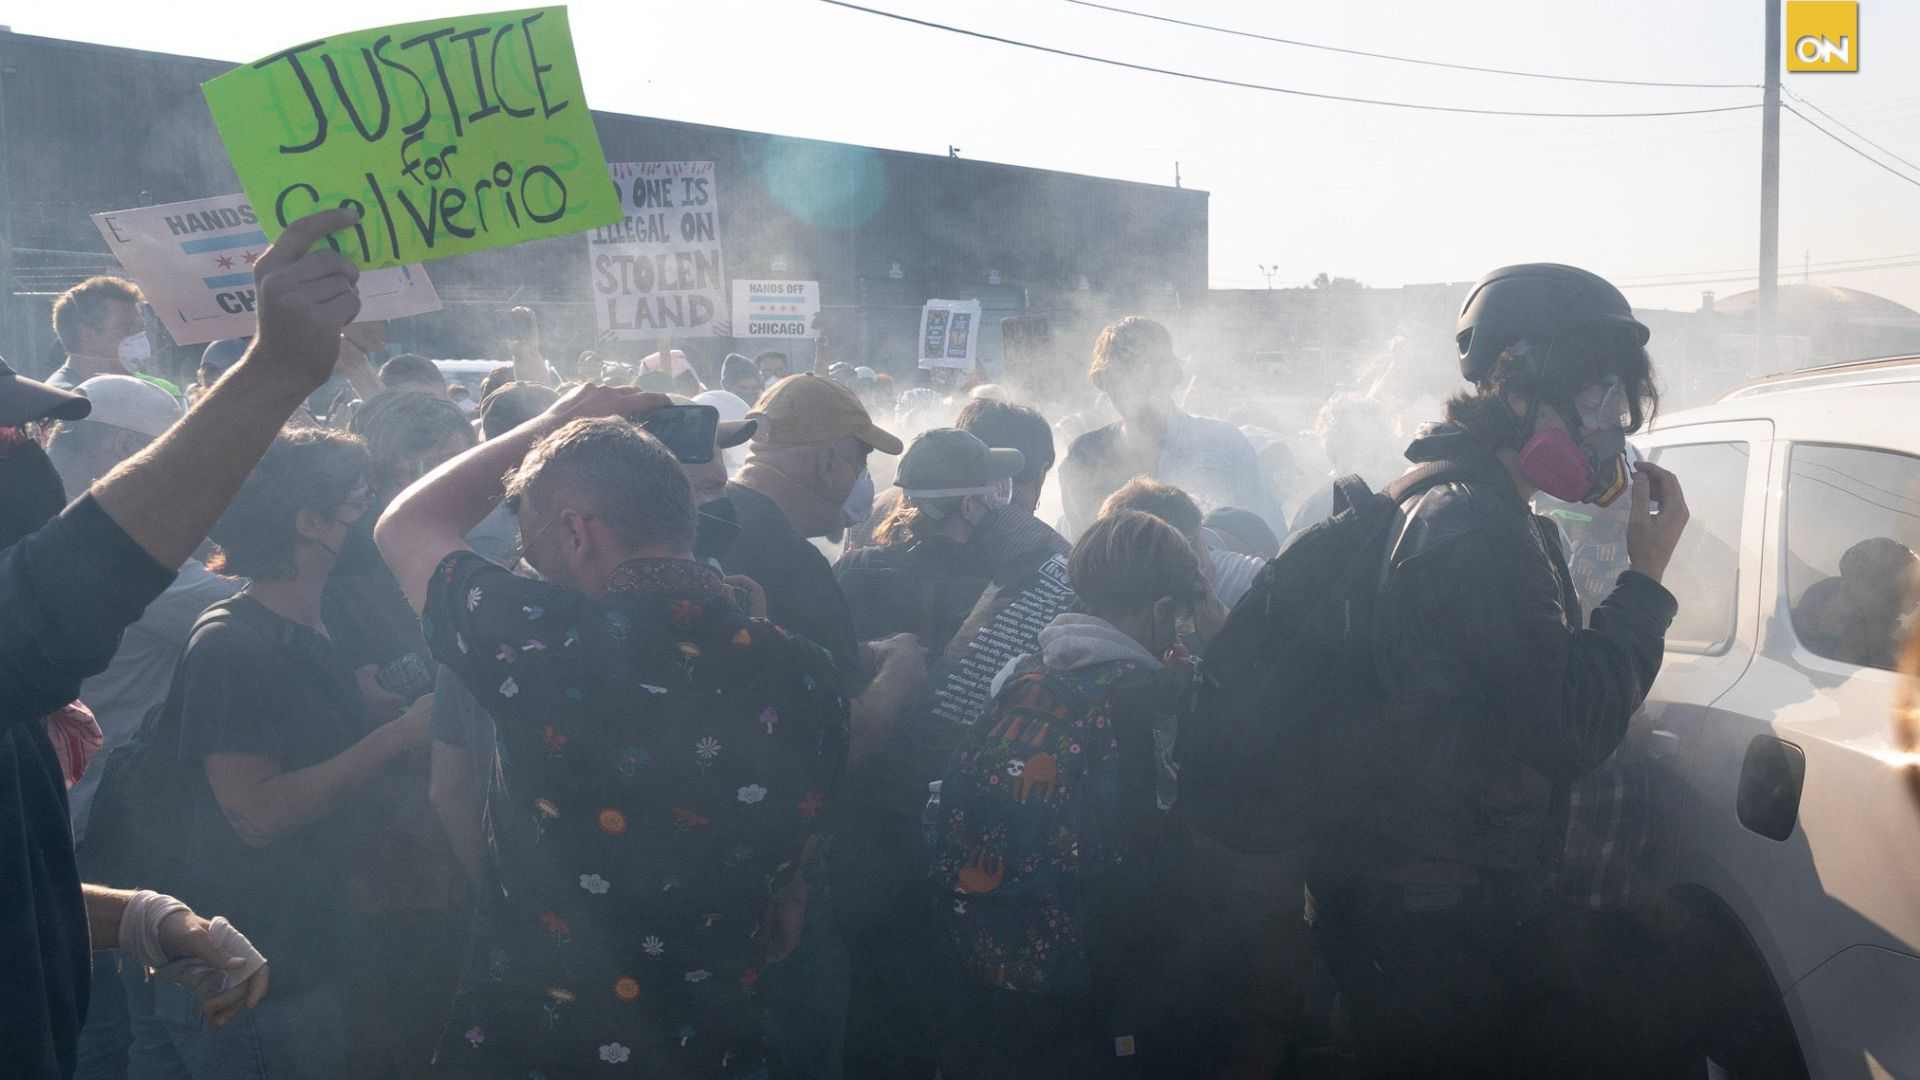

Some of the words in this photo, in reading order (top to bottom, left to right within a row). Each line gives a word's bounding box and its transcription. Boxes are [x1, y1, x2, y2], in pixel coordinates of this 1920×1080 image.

[253, 12, 569, 154] JUSTICE
[400, 131, 457, 185] for
[632, 176, 674, 208] ONE
[680, 176, 710, 206] IS
[164, 204, 257, 236] HANDS
[680, 212, 715, 243] ON
[595, 250, 721, 295] STOLEN
[749, 283, 785, 294] HANDS
[787, 283, 805, 294] OFF
[608, 294, 715, 330] LAND
[749, 322, 805, 335] CHICAGO
